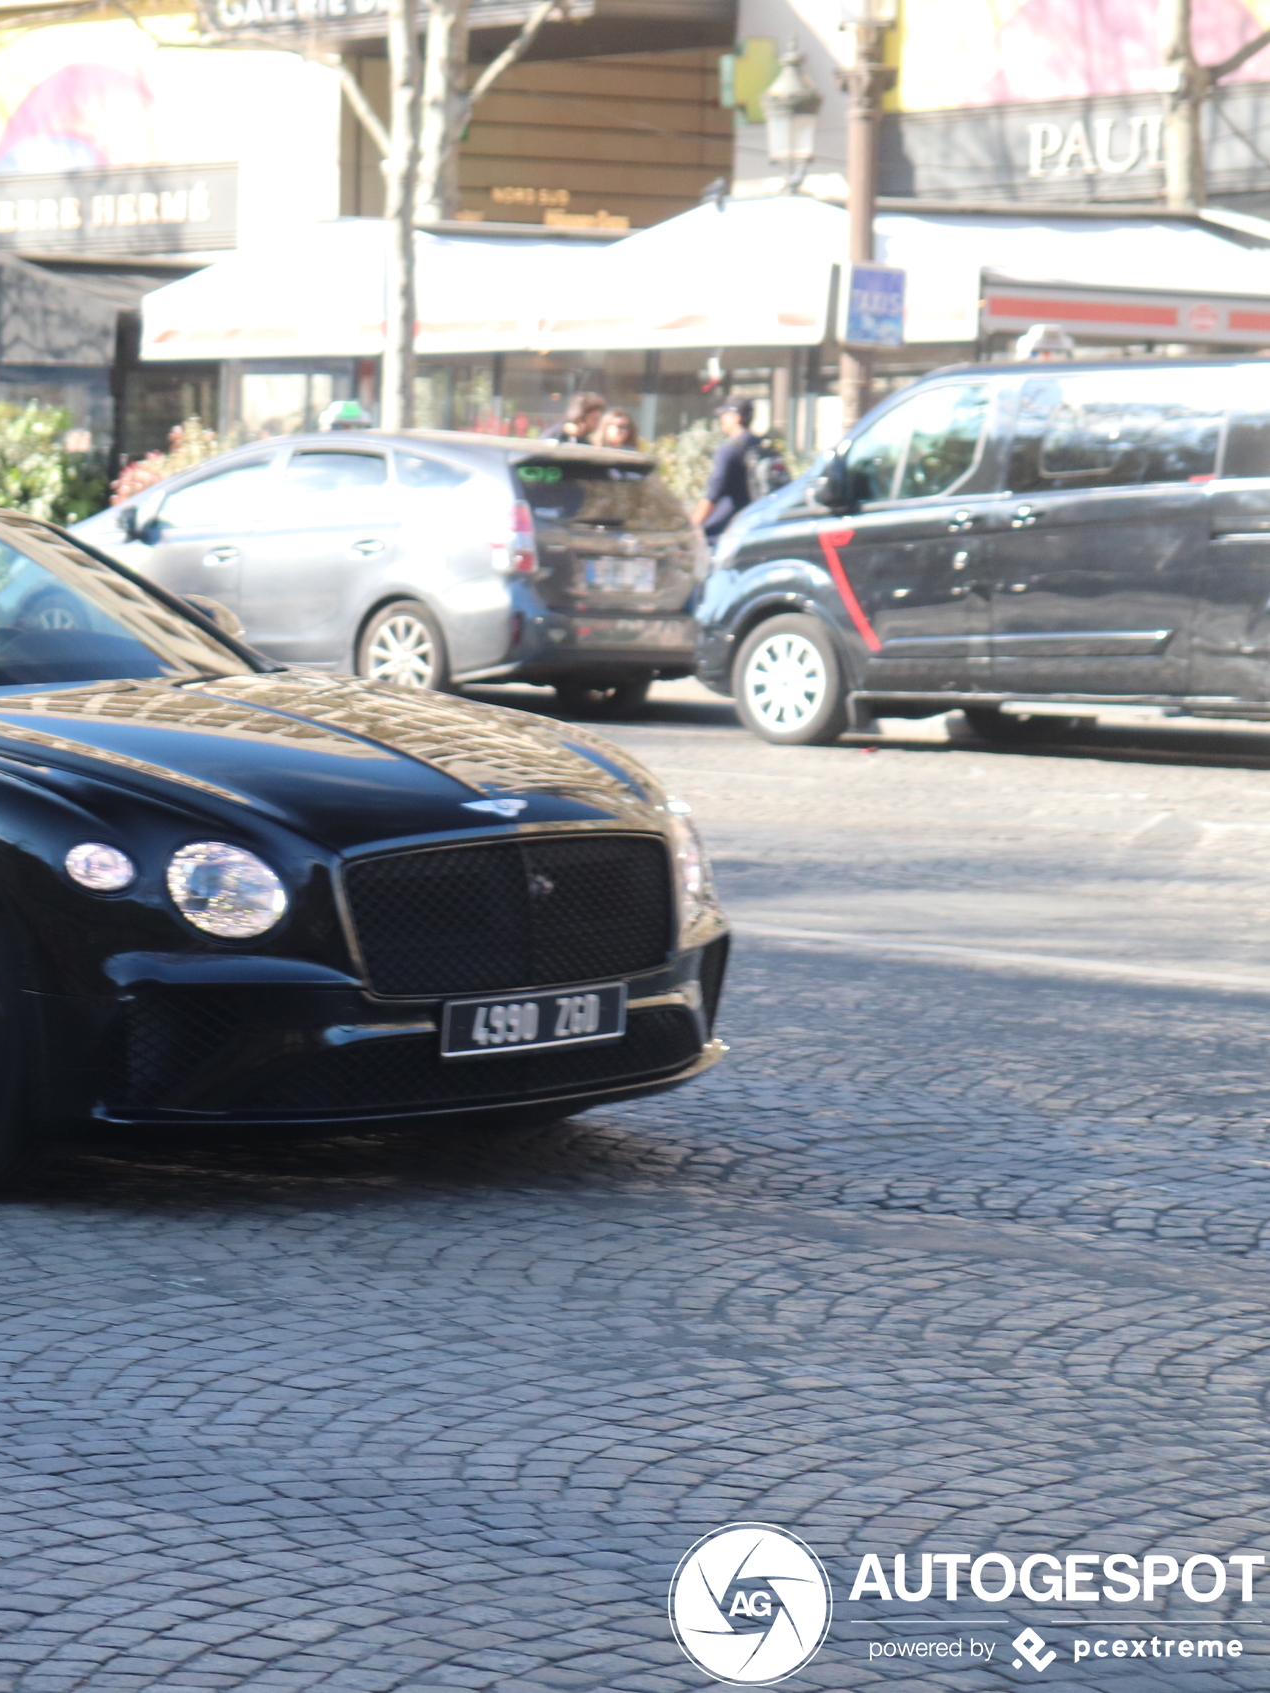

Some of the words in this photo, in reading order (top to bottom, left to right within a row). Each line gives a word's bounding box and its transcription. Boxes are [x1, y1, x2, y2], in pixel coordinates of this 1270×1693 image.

[1027, 114, 1168, 178] PAUL
[91, 180, 211, 227] HERMÉ
[472, 1001, 540, 1046] 4990
